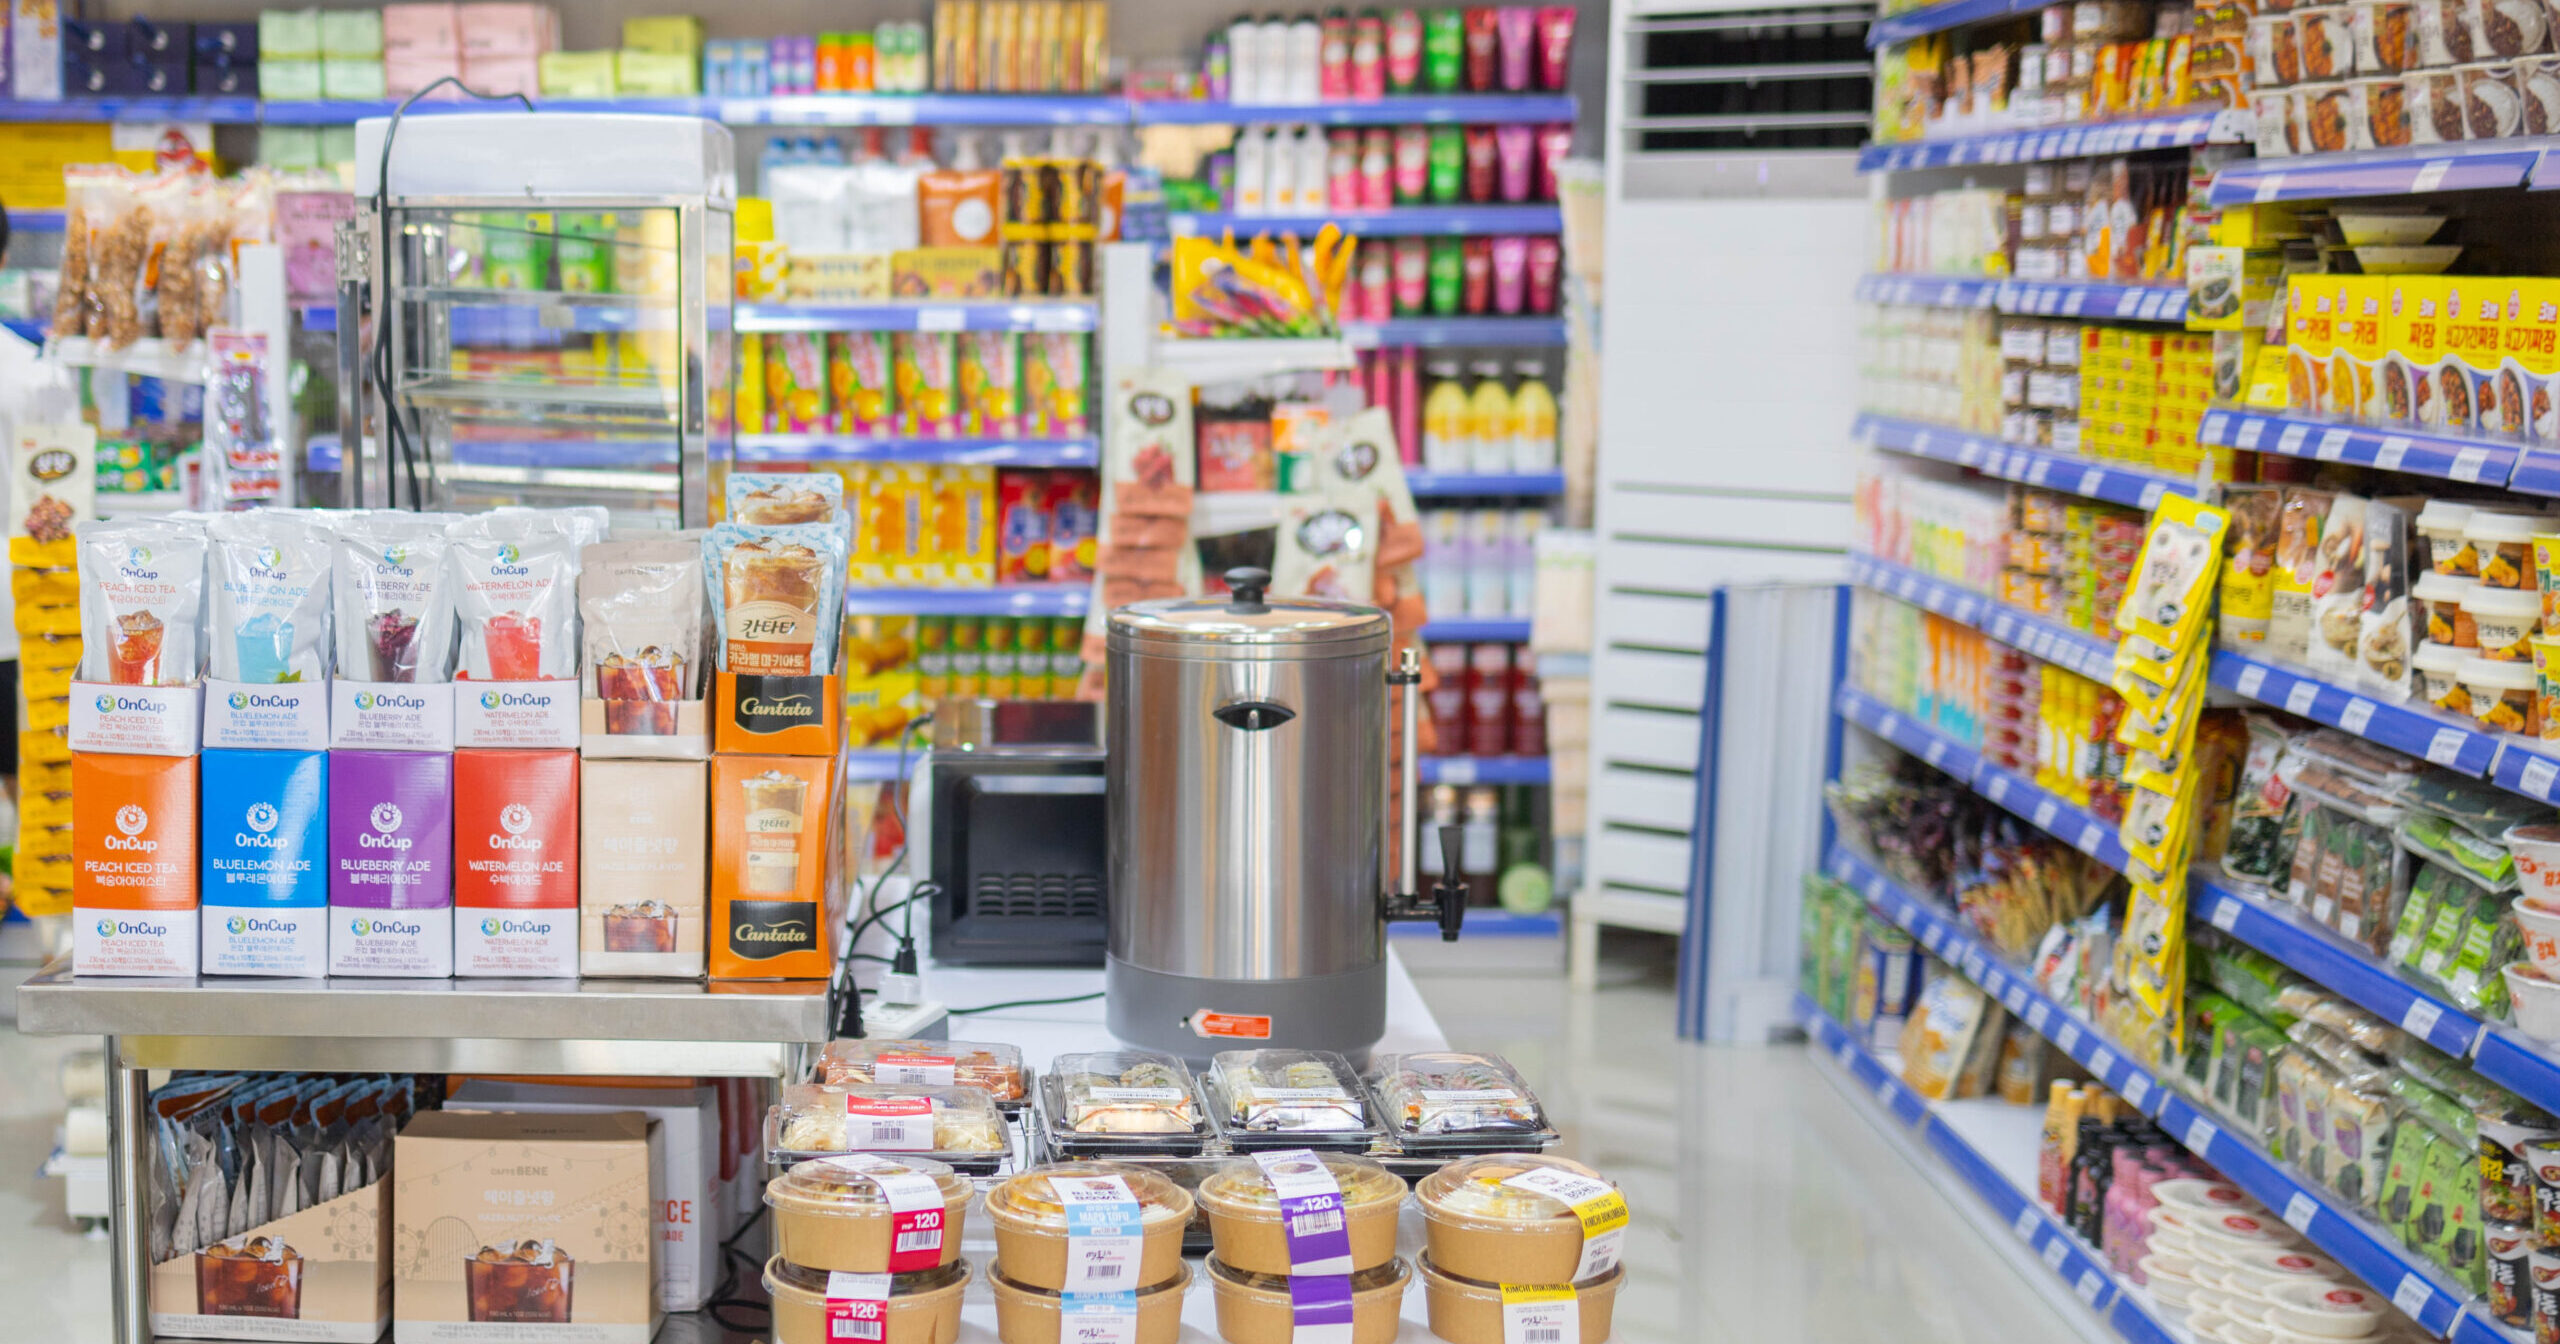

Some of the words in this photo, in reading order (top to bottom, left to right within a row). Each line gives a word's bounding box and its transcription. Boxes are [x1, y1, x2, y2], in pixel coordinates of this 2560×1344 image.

[121, 567, 158, 581] OnCup
[250, 567, 287, 581] OnCup
[377, 564, 414, 577] OnCup
[491, 564, 528, 577] OnCup
[159, 584, 176, 594] TEA
[741, 619, 797, 639] 칸타타
[729, 651, 760, 667] 카라멜
[117, 697, 167, 714] OnCup
[249, 694, 299, 710] OnCup
[376, 694, 425, 710] OnCup
[502, 692, 551, 708] OnCup
[740, 697, 813, 716] Cantata
[100, 715, 125, 724] PEACH
[230, 711, 280, 721] BLUELEMON
[282, 711, 298, 721] ADE
[359, 712, 403, 722] BLUEBERRY
[405, 712, 422, 722] ADE
[484, 710, 533, 720] WATERMELON
[534, 710, 549, 720] ADE
[104, 834, 158, 853] OnCup
[235, 832, 288, 851] OnCup
[359, 832, 412, 851] OnCup
[489, 833, 542, 851] OnCup
[85, 860, 123, 873] PEACH
[125, 861, 152, 874] ICED
[155, 862, 178, 874] TEA
[213, 858, 285, 871] BLUELEMON
[287, 859, 311, 871] ADE
[340, 858, 404, 871] BLUEBERRY
[406, 859, 432, 872] ADE
[468, 860, 539, 873] WATERMELON
[541, 861, 564, 873] ADE
[95, 874, 167, 889] 복숭아아이스티
[226, 872, 298, 885] 블루레몬에이드
[350, 873, 422, 886] 블루베리에이드
[489, 874, 543, 887] 수박에이드
[118, 921, 167, 937] OnCup
[248, 918, 297, 934] OnCup
[372, 920, 421, 936] OnCup
[502, 920, 551, 936] OnCup
[735, 923, 807, 942] Cantata
[101, 938, 126, 948] PEACH
[148, 939, 164, 948] TEA
[228, 936, 277, 945] BLUELEMON
[279, 936, 296, 945] ADE
[355, 938, 399, 947] BLUEBERRY
[401, 938, 417, 947] ADE
[484, 938, 533, 947] WATERMELON
[534, 938, 549, 947] ADE
[1304, 1195, 1333, 1211] 120
[666, 1199, 692, 1224] CE
[914, 1212, 940, 1229] 120
[849, 1304, 878, 1319] 120
